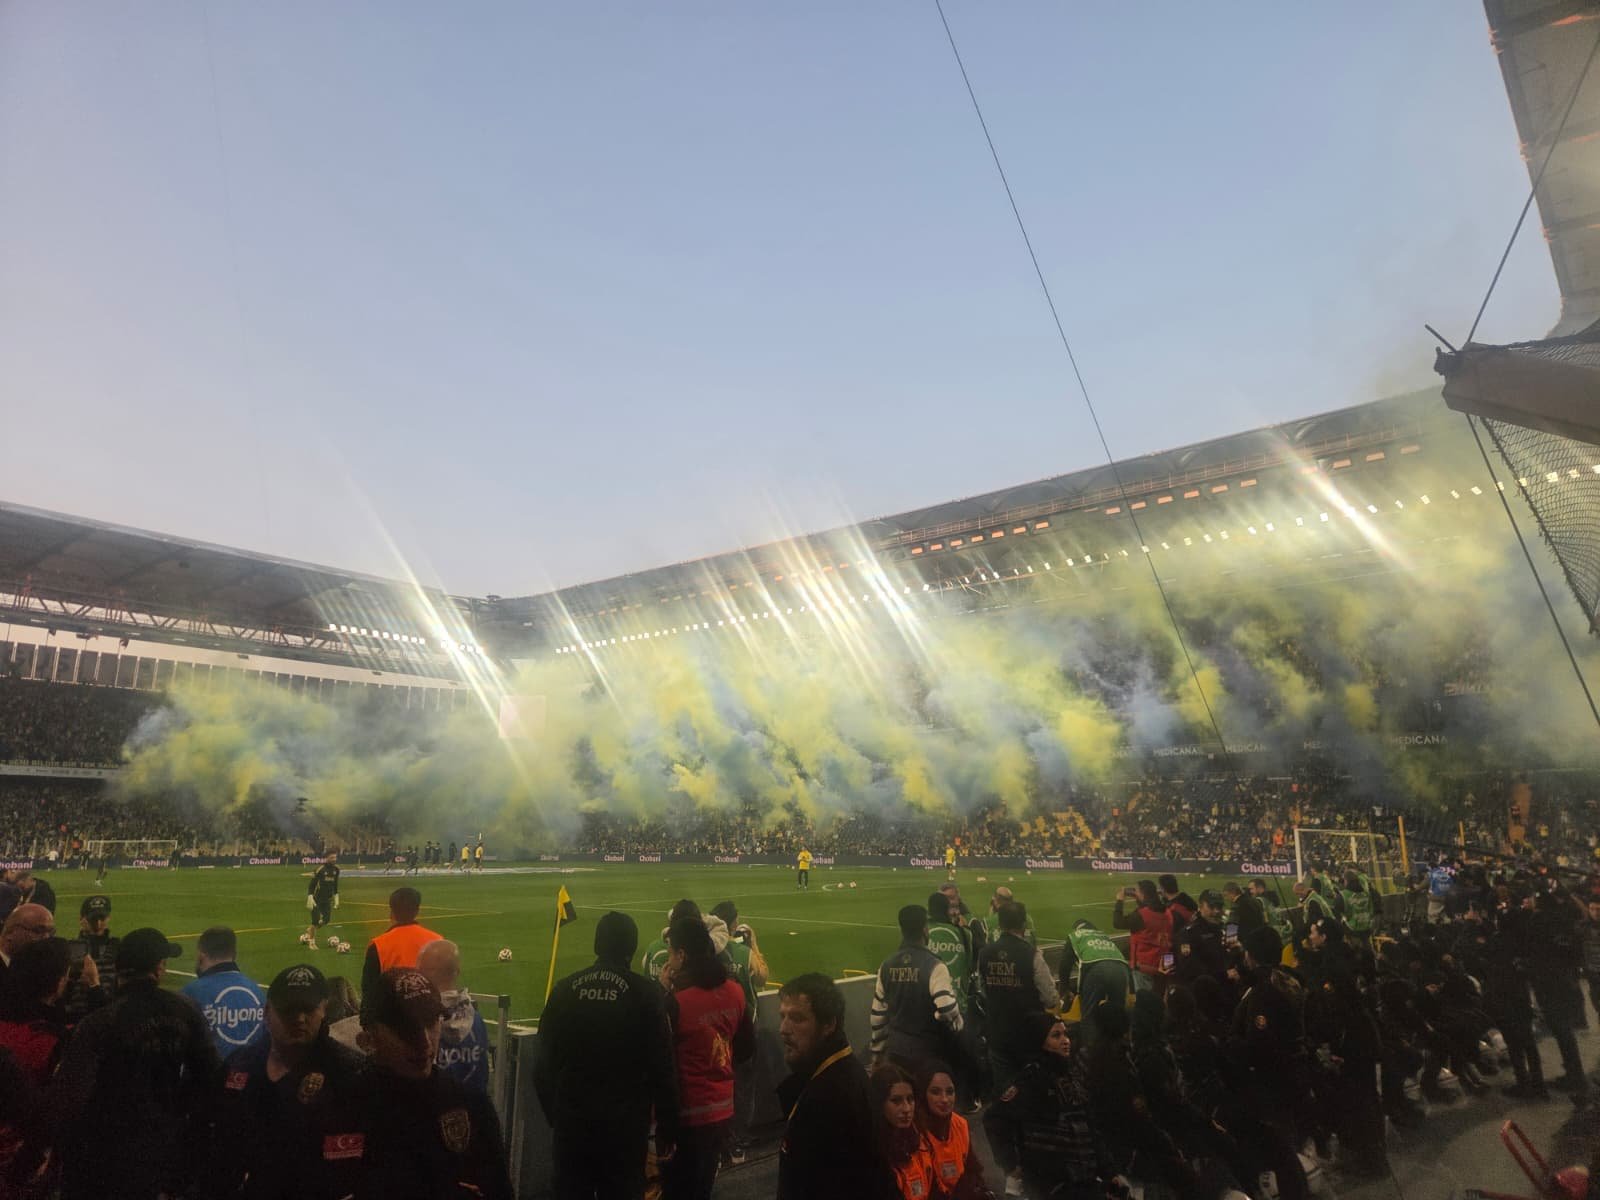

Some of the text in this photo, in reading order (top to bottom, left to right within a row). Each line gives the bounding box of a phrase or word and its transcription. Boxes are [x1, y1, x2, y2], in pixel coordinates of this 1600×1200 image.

[1391, 735, 1448, 745] MEDICANA
[1225, 743, 1267, 753] MEDICAN
[249, 857, 281, 865] Chobani
[714, 855, 739, 863] Chobani
[910, 857, 943, 866] Chobani
[1025, 859, 1064, 869] Chobani
[0, 861, 33, 869] hobani
[1091, 860, 1133, 870] Chobani
[1240, 863, 1292, 873] Chobani
[988, 961, 1016, 976] TEM
[889, 967, 920, 983] TEM
[579, 988, 618, 1001] POLİS
